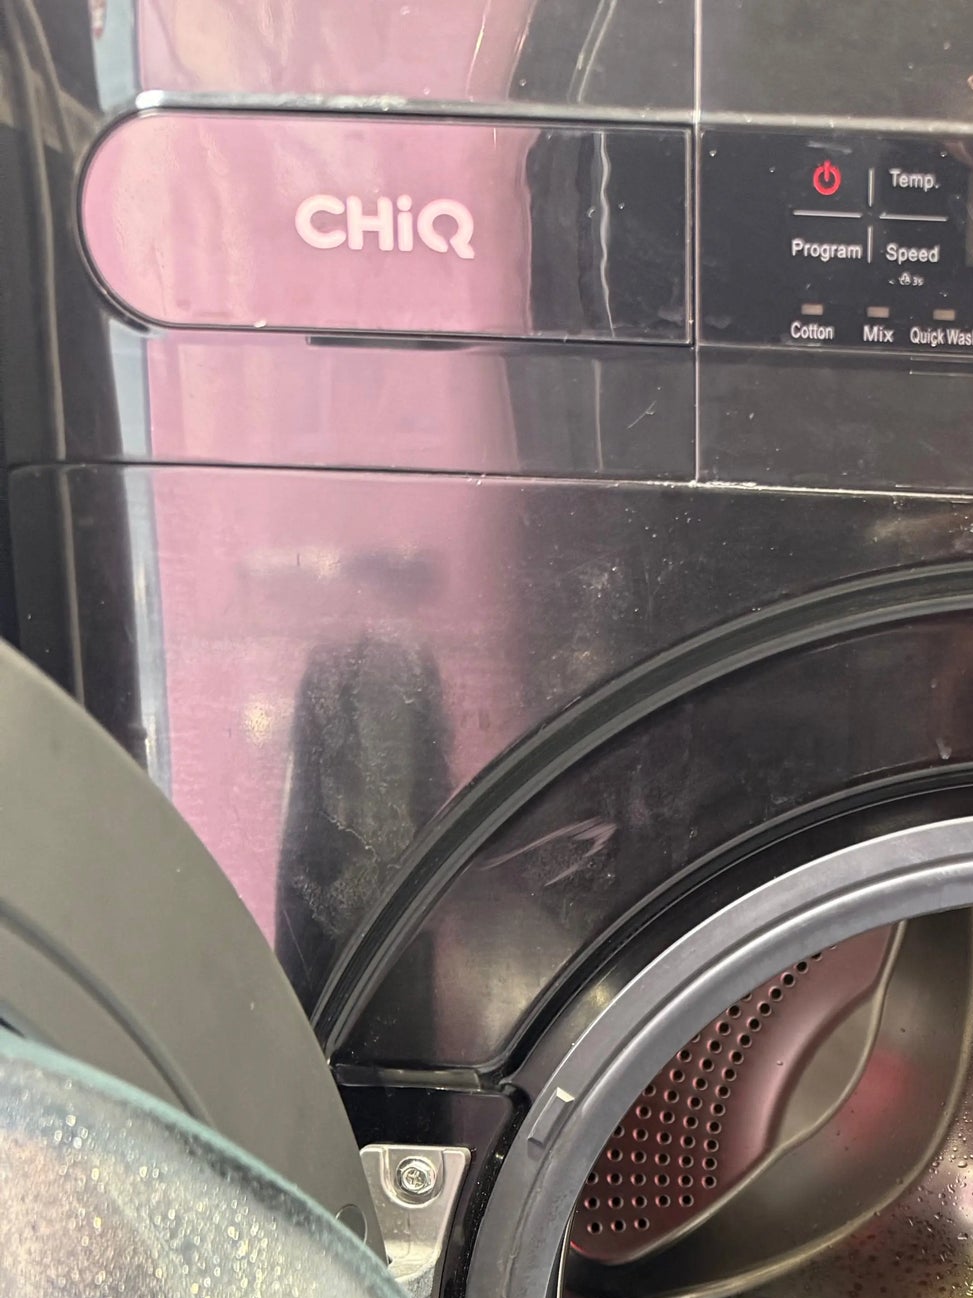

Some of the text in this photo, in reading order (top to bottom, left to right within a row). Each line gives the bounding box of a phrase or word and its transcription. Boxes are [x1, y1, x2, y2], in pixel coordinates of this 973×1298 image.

[889, 168, 941, 191] Temp.
[294, 194, 475, 259] CHiQ
[791, 238, 863, 262] Program
[885, 243, 939, 264] Speed
[790, 321, 834, 340] Cotton
[863, 325, 894, 343] Mix
[910, 329, 945, 348] Quick
